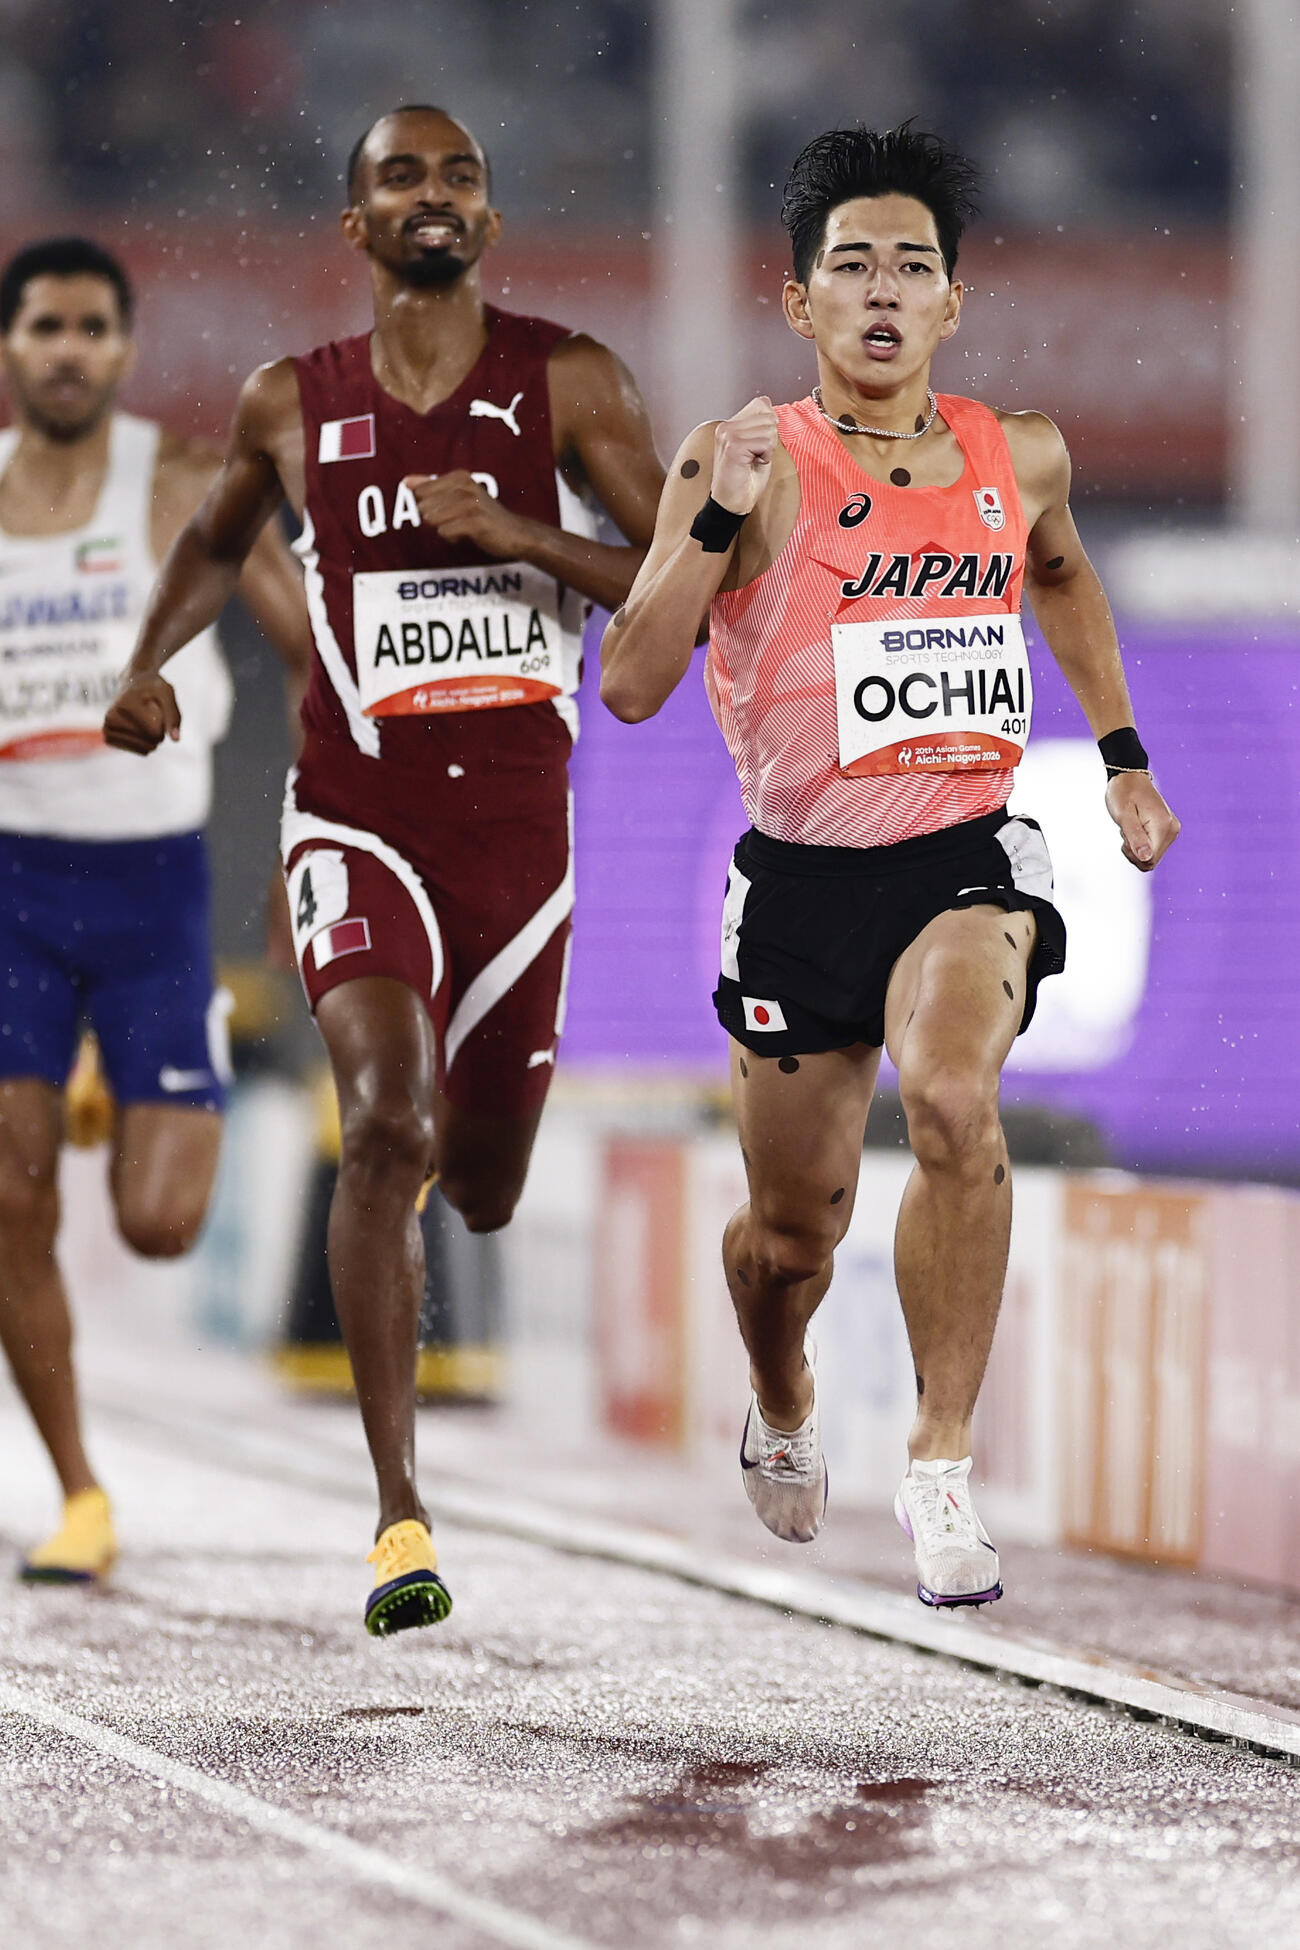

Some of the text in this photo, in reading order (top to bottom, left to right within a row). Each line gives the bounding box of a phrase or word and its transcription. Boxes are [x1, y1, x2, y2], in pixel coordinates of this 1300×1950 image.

[397, 573, 522, 600] BORNAN
[841, 552, 1015, 599] JAPAN
[373, 607, 549, 668] ABDALLA
[882, 625, 1004, 652] BORNAN
[520, 655, 550, 674] 609
[885, 649, 1004, 666] SPORTS TECHNOLOGY
[853, 667, 1026, 722] OCHIAI
[1001, 718, 1026, 735] 401
[914, 746, 934, 755] 20th
[935, 745, 958, 754] Asian
[914, 751, 1002, 765] Aichi-Nagoya 2026
[297, 866, 318, 932] 4
